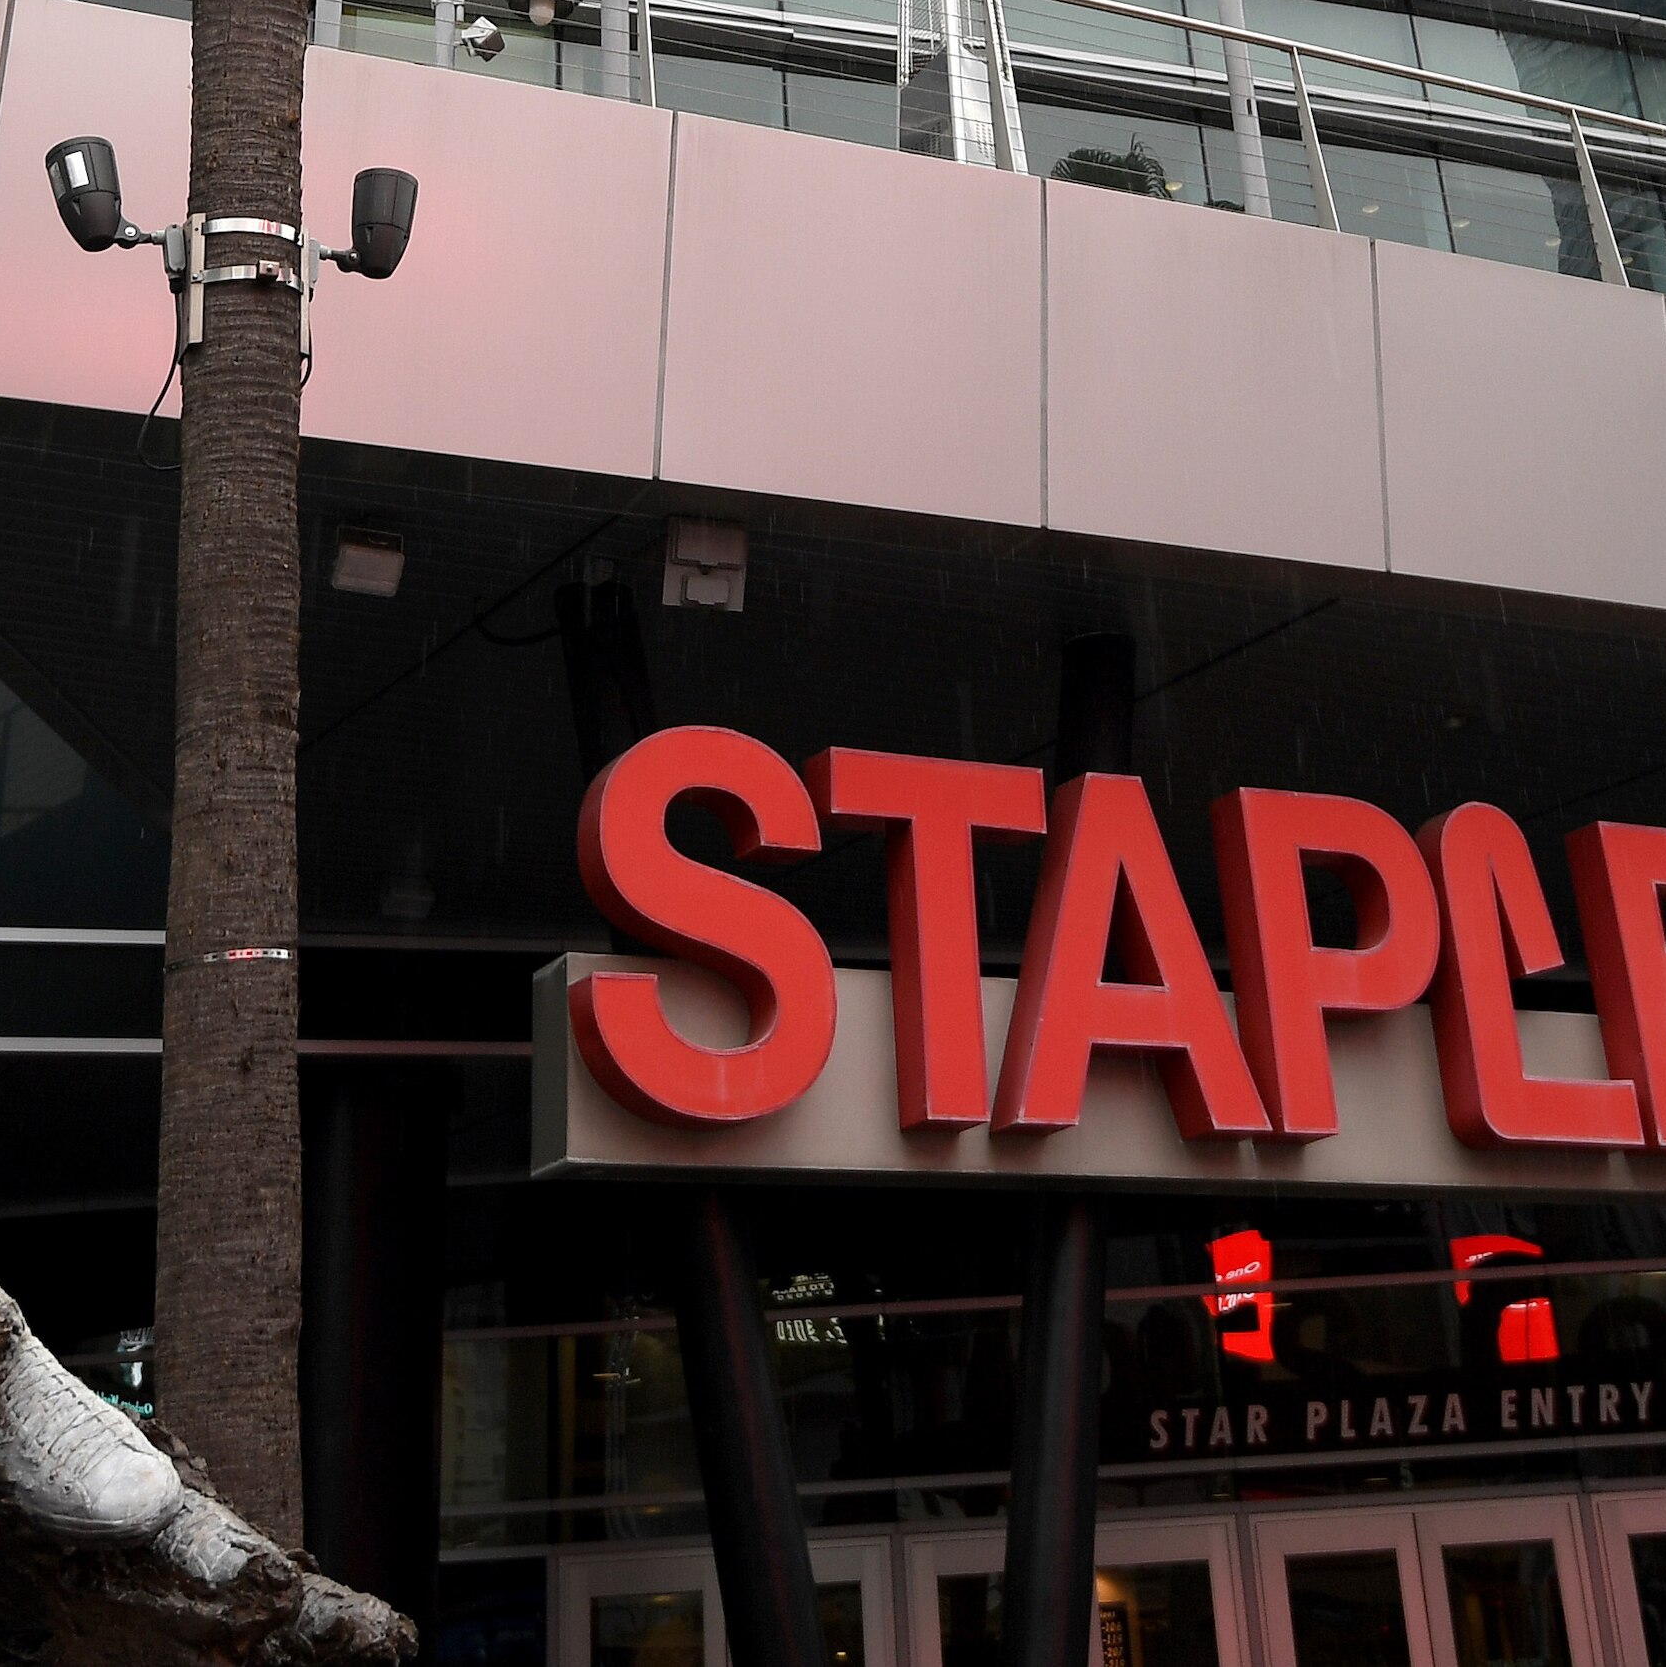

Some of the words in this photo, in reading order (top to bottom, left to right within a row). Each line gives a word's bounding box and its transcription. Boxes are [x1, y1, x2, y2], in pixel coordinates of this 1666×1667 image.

[1149, 1403, 1273, 1451] STAR
[1306, 1393, 1467, 1441] PLAZA
[1501, 1380, 1654, 1430] ENTRY
